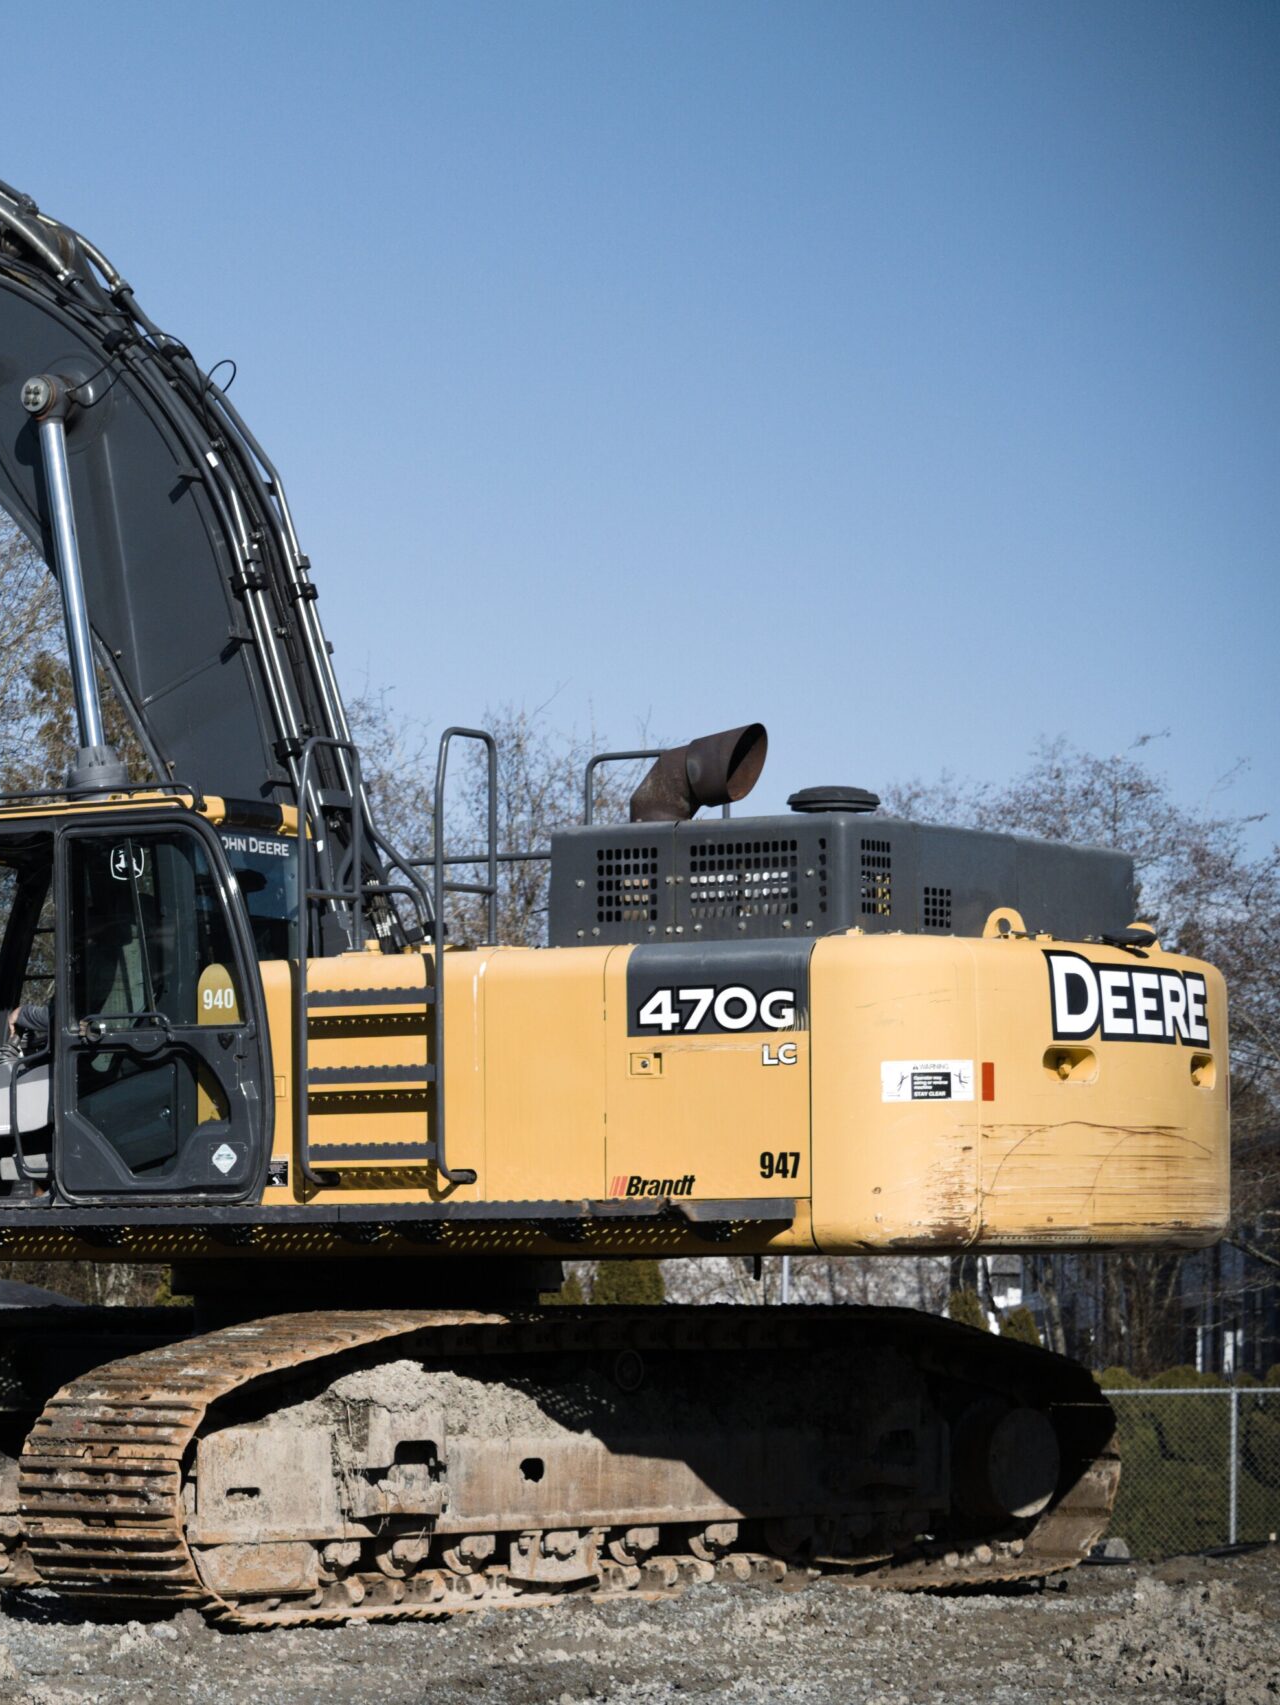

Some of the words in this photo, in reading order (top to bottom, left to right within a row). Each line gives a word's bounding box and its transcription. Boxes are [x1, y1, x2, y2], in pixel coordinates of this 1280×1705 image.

[221, 836, 246, 852] OHN
[249, 836, 289, 856] DEERE
[203, 988, 234, 1010] 940
[638, 985, 796, 1031] 470G
[1047, 953, 1209, 1043] DEERE
[762, 1043, 798, 1066] LC
[760, 1151, 800, 1179] 947
[626, 1175, 696, 1197] Brandt
